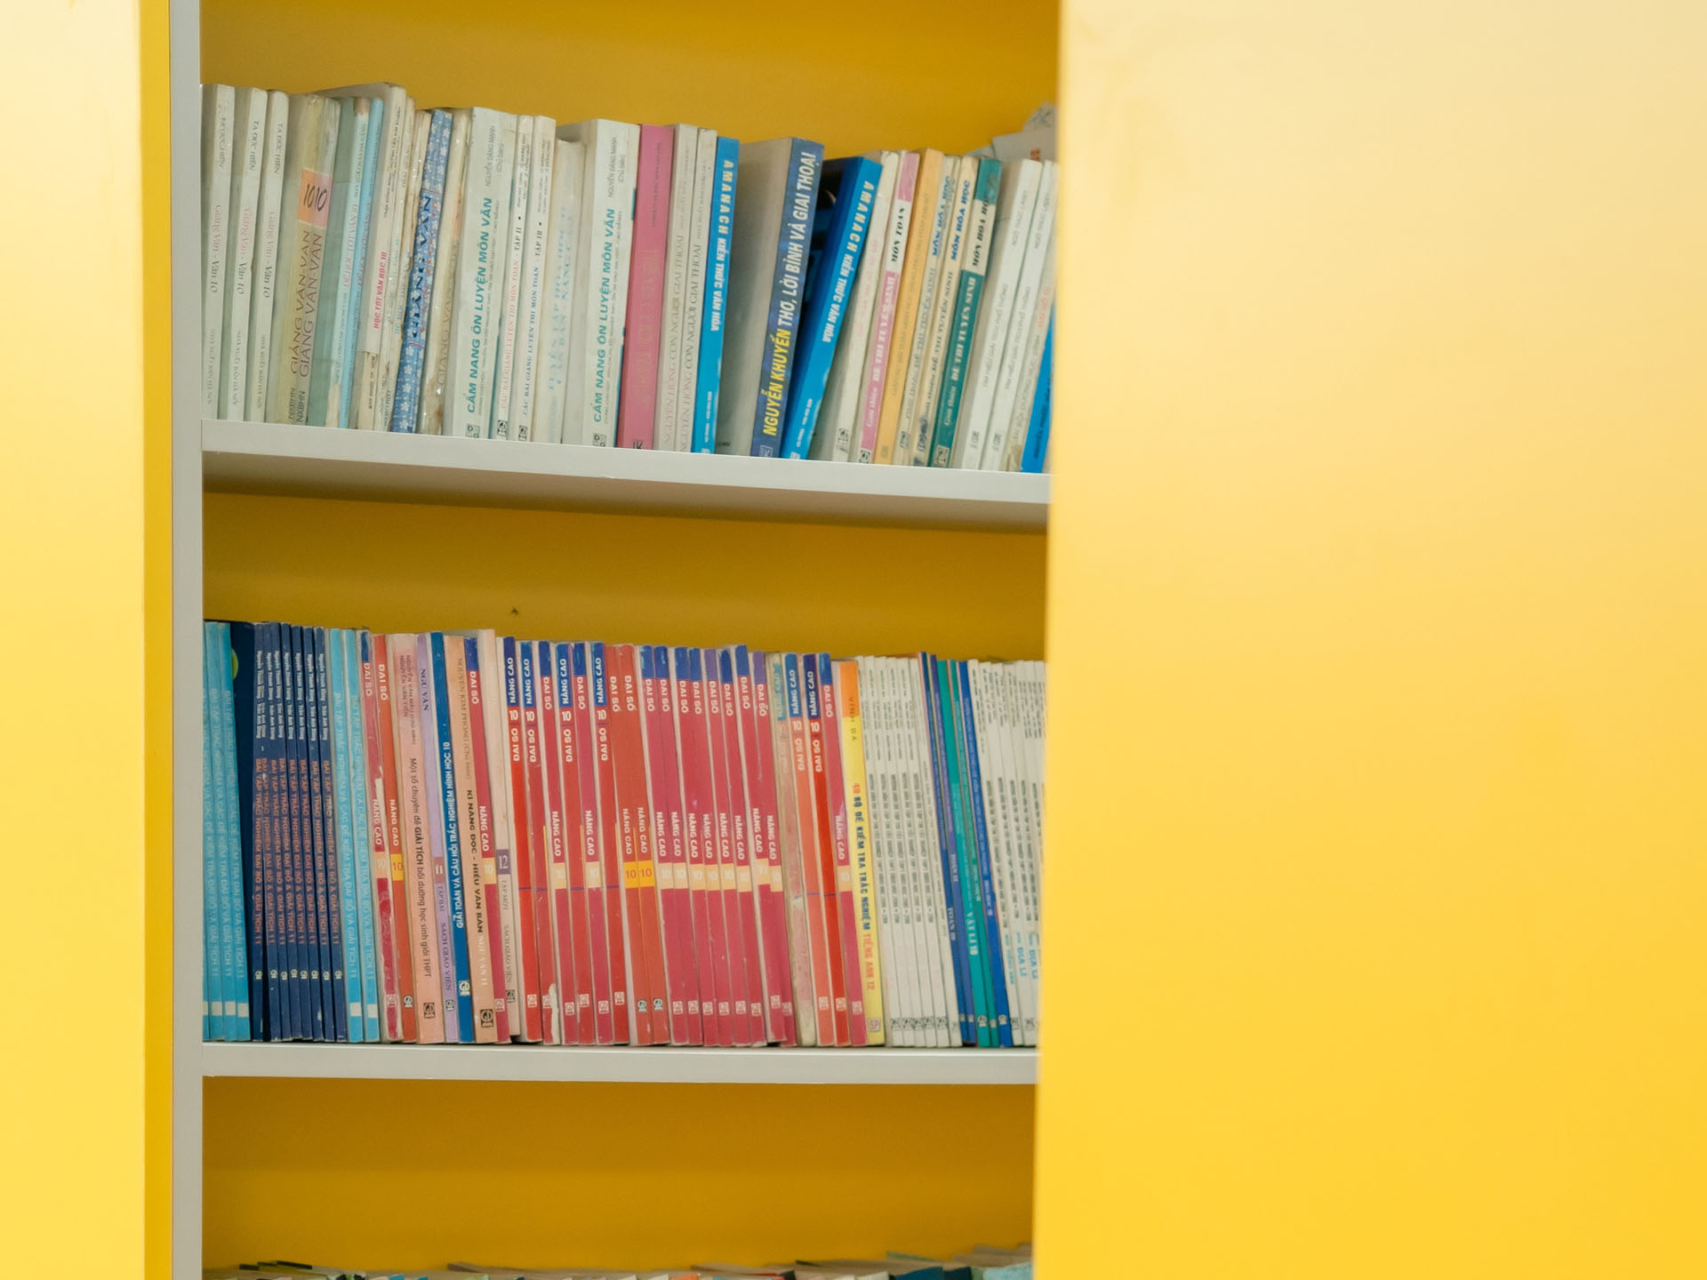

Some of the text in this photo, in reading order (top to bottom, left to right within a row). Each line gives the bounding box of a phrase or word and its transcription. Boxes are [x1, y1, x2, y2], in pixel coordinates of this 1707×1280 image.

[796, 152, 820, 191] THOẠI
[480, 197, 492, 227] VĂN
[792, 192, 810, 220] GIAI
[604, 208, 615, 237] VĂN
[788, 223, 806, 240] VÀ
[477, 231, 488, 263] MÔN
[601, 241, 612, 274] MÔN
[785, 242, 803, 273] BÌNH
[474, 266, 488, 311] LUYỆN
[599, 277, 612, 321] LUYỆN
[472, 315, 482, 334] ÔN
[596, 324, 607, 344] ÔN
[469, 339, 480, 378] NANG
[595, 349, 605, 388] NANG
[770, 328, 791, 381] KHUYẾN
[463, 382, 477, 413] CẨM
[590, 392, 602, 422] CẨM
[762, 381, 783, 435] NGUYỄN
[507, 657, 515, 675] CAO
[442, 741, 450, 750] 10
[409, 758, 417, 773] Một
[410, 786, 420, 813] chuyên
[414, 826, 424, 844] GIẢI
[624, 835, 633, 854] CAO
[658, 838, 666, 856] CAO
[415, 846, 424, 865] TÍCH
[420, 923, 429, 939] sinh
[423, 958, 432, 977] THPT
